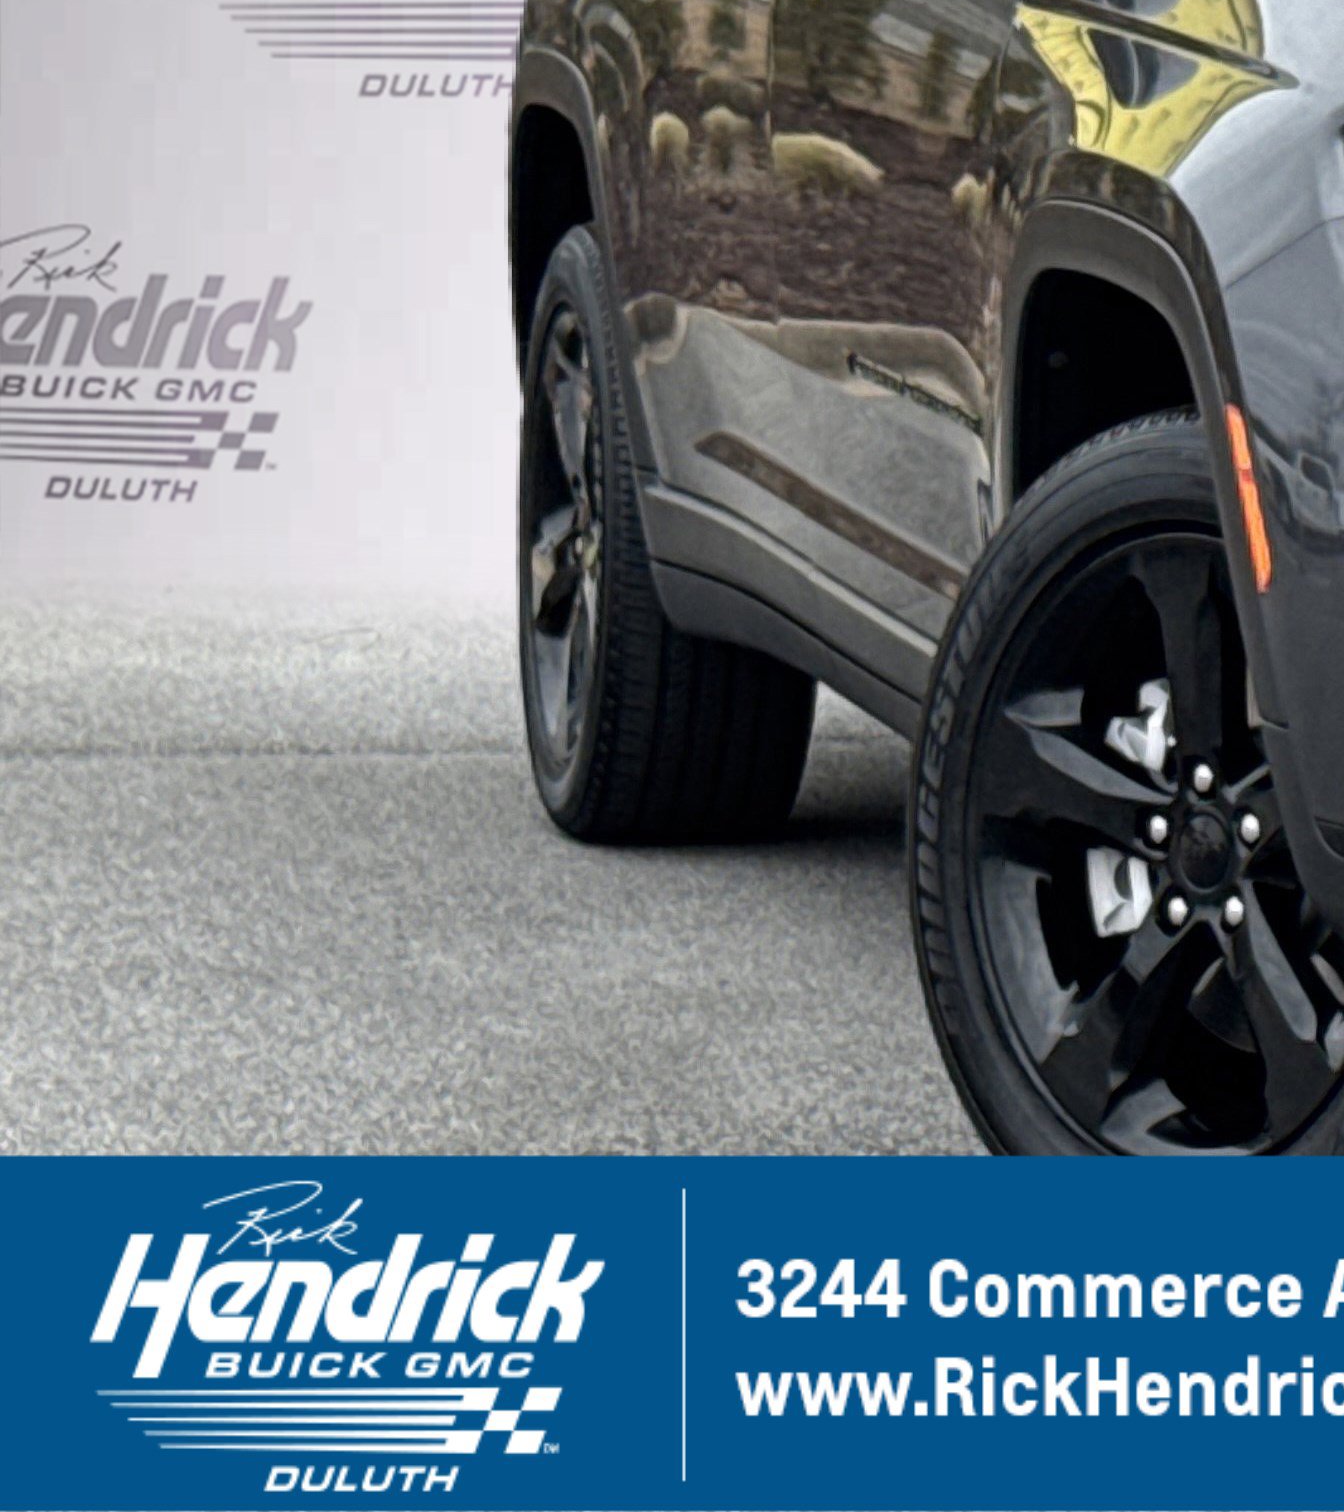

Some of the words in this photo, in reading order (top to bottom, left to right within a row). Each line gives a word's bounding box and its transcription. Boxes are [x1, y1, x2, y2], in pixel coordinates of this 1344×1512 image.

[0, 274, 312, 372] endrick
[0, 375, 138, 400] BUICK
[155, 381, 257, 403] GMC
[44, 476, 199, 502] DULUTH
